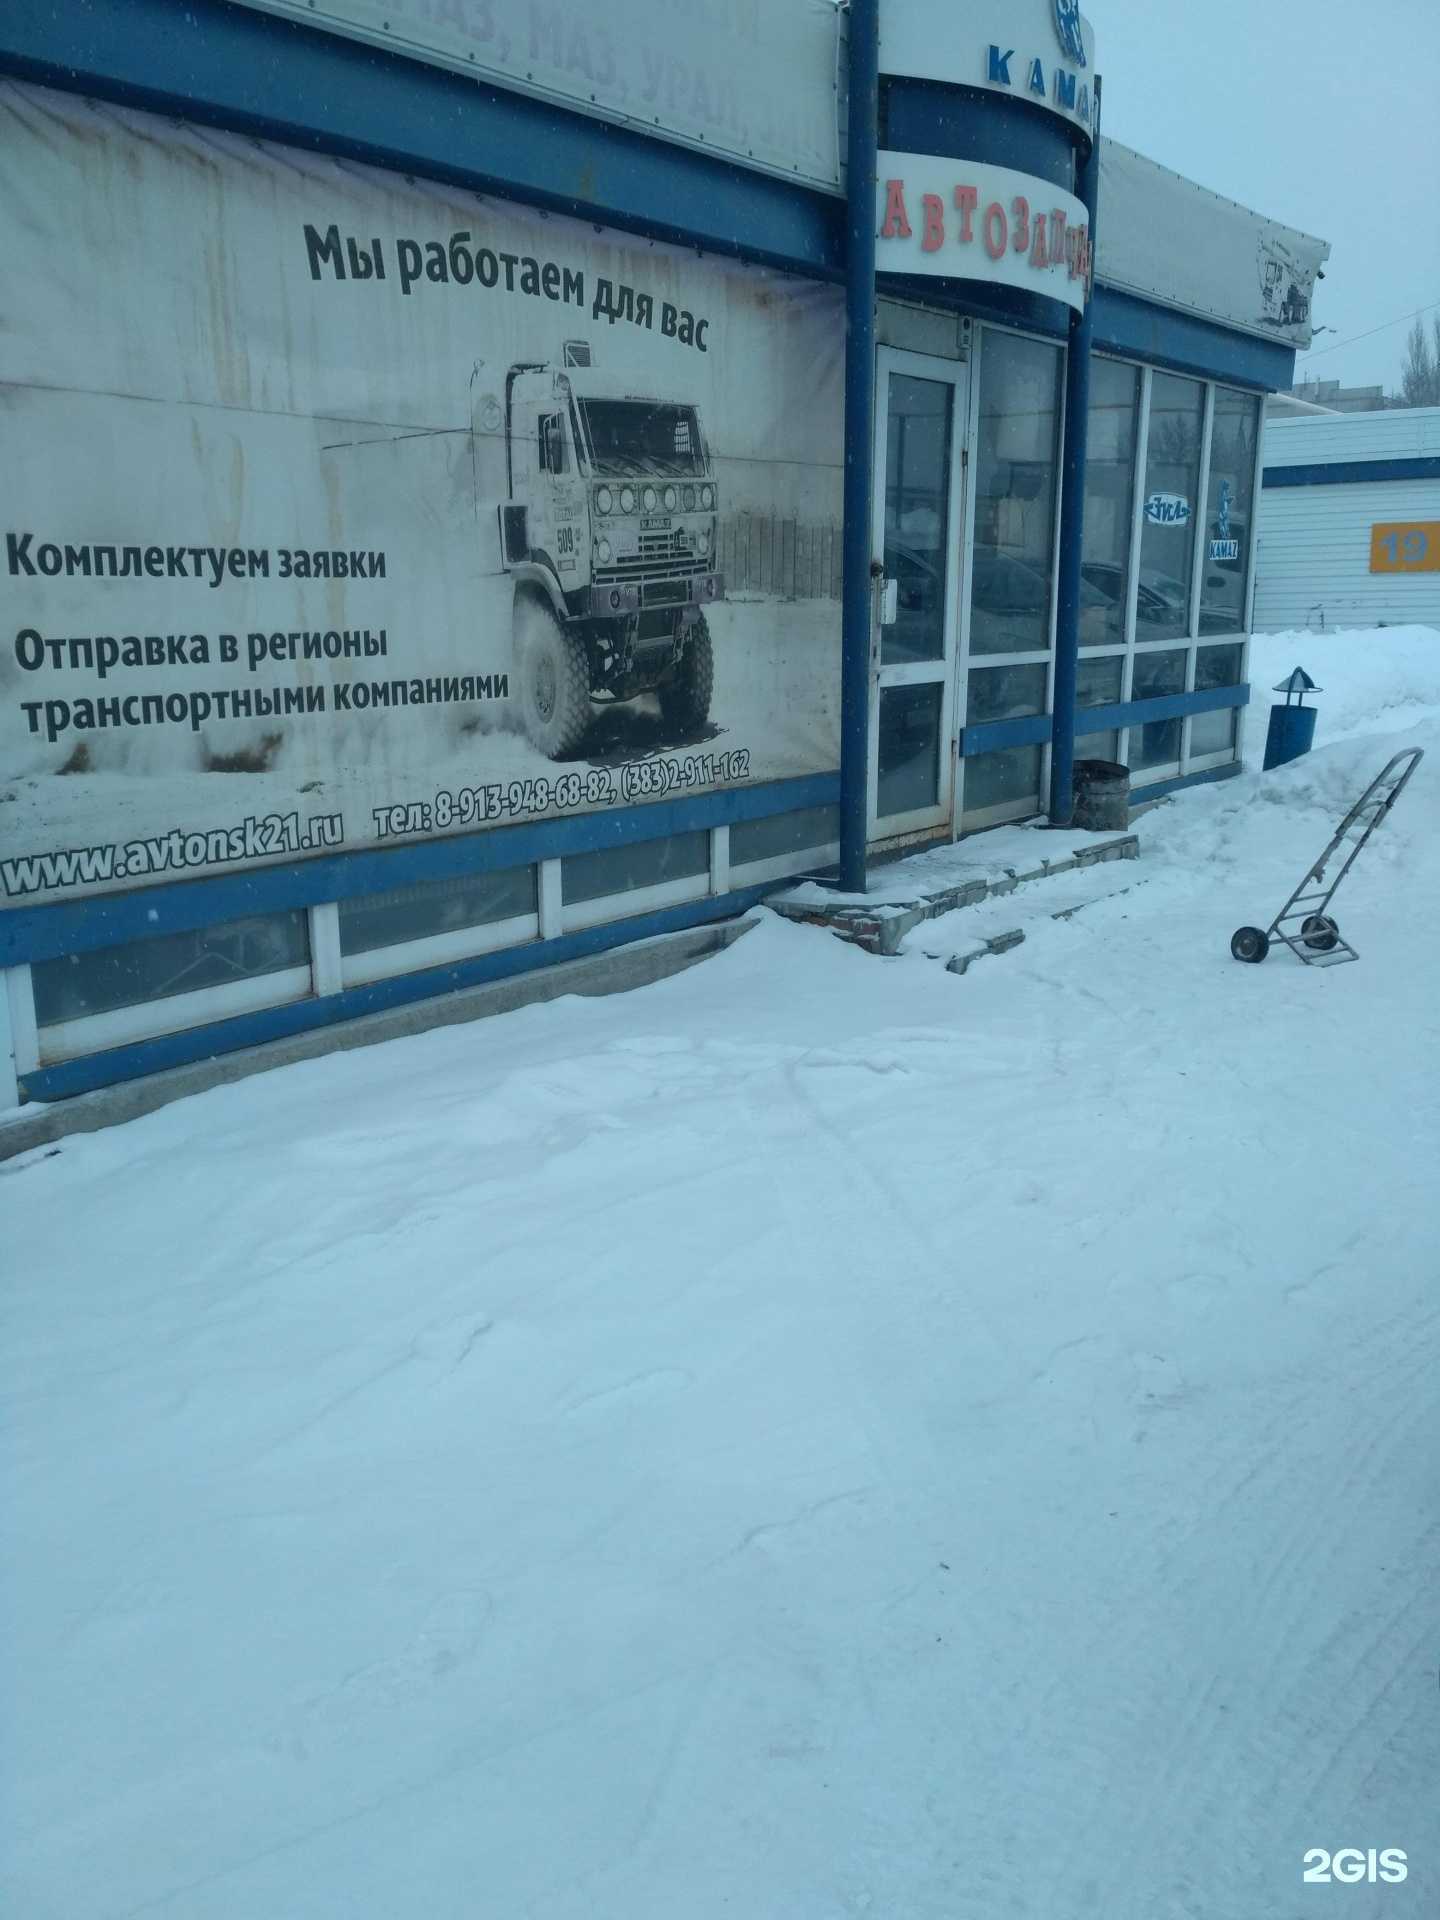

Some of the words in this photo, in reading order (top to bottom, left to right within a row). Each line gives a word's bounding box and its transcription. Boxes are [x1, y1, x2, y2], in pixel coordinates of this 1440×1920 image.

[303, 224, 386, 281] Мы
[396, 231, 585, 307] работаем
[592, 278, 653, 330] для
[661, 302, 710, 352] вас
[6, 533, 269, 588] Комплектуем
[278, 549, 386, 578] заявки
[557, 527, 574, 553] 509
[1210, 541, 1237, 558] KAMAZ
[1380, 530, 1429, 563] 19
[15, 628, 209, 678] Отправка
[219, 634, 238, 662] в
[247, 630, 388, 671] регионы
[20, 685, 325, 742] транспортными
[333, 674, 509, 711] компаниями
[372, 801, 432, 838] тел:
[620, 749, 750, 802] (383)2-911-162
[1, 812, 344, 896] www.avtonsk21.ru
